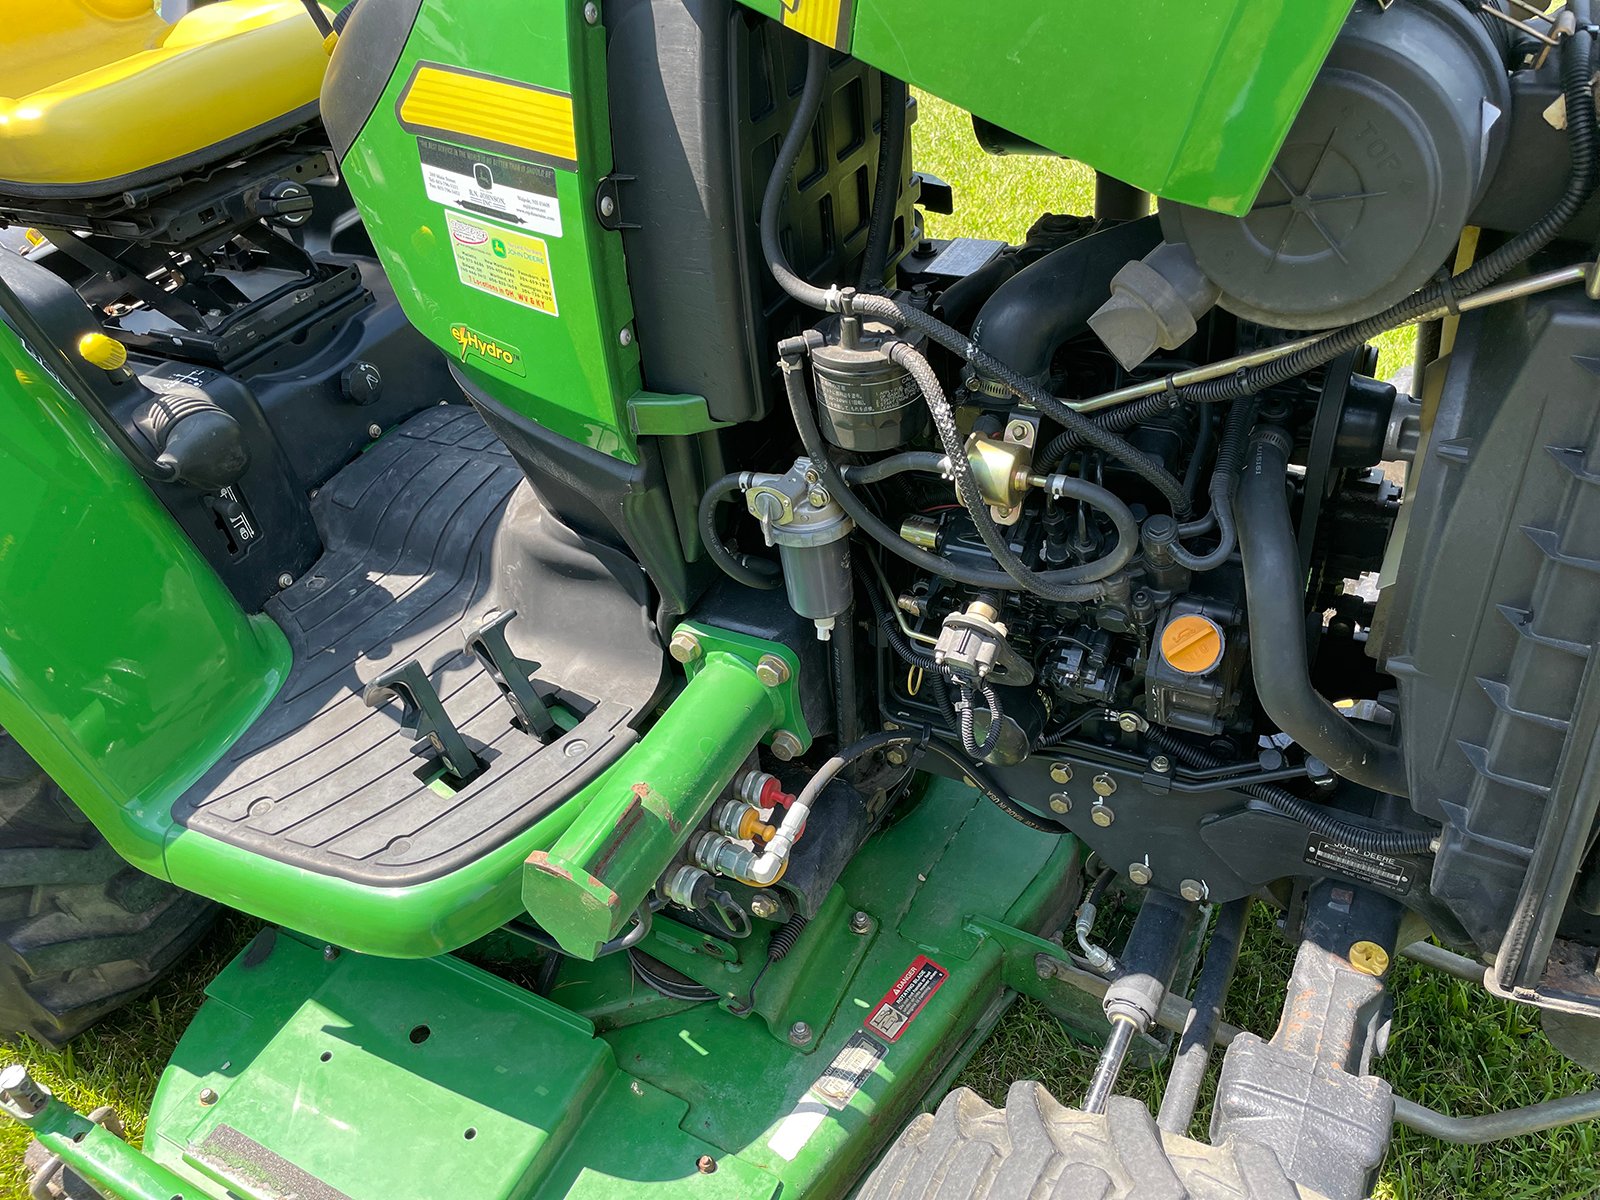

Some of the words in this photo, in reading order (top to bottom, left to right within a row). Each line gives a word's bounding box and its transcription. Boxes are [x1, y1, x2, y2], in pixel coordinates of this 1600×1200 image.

[1352, 119, 1402, 170] TOP
[517, 292, 528, 302] WV
[535, 298, 545, 308] KY
[986, 790, 1000, 804] USA
[1333, 840, 1359, 853] JOHN
[1363, 849, 1395, 864] DEERE
[895, 982, 914, 1004] ROTATING
[912, 969, 926, 984] BLADE
[896, 966, 917, 989] DANGER
